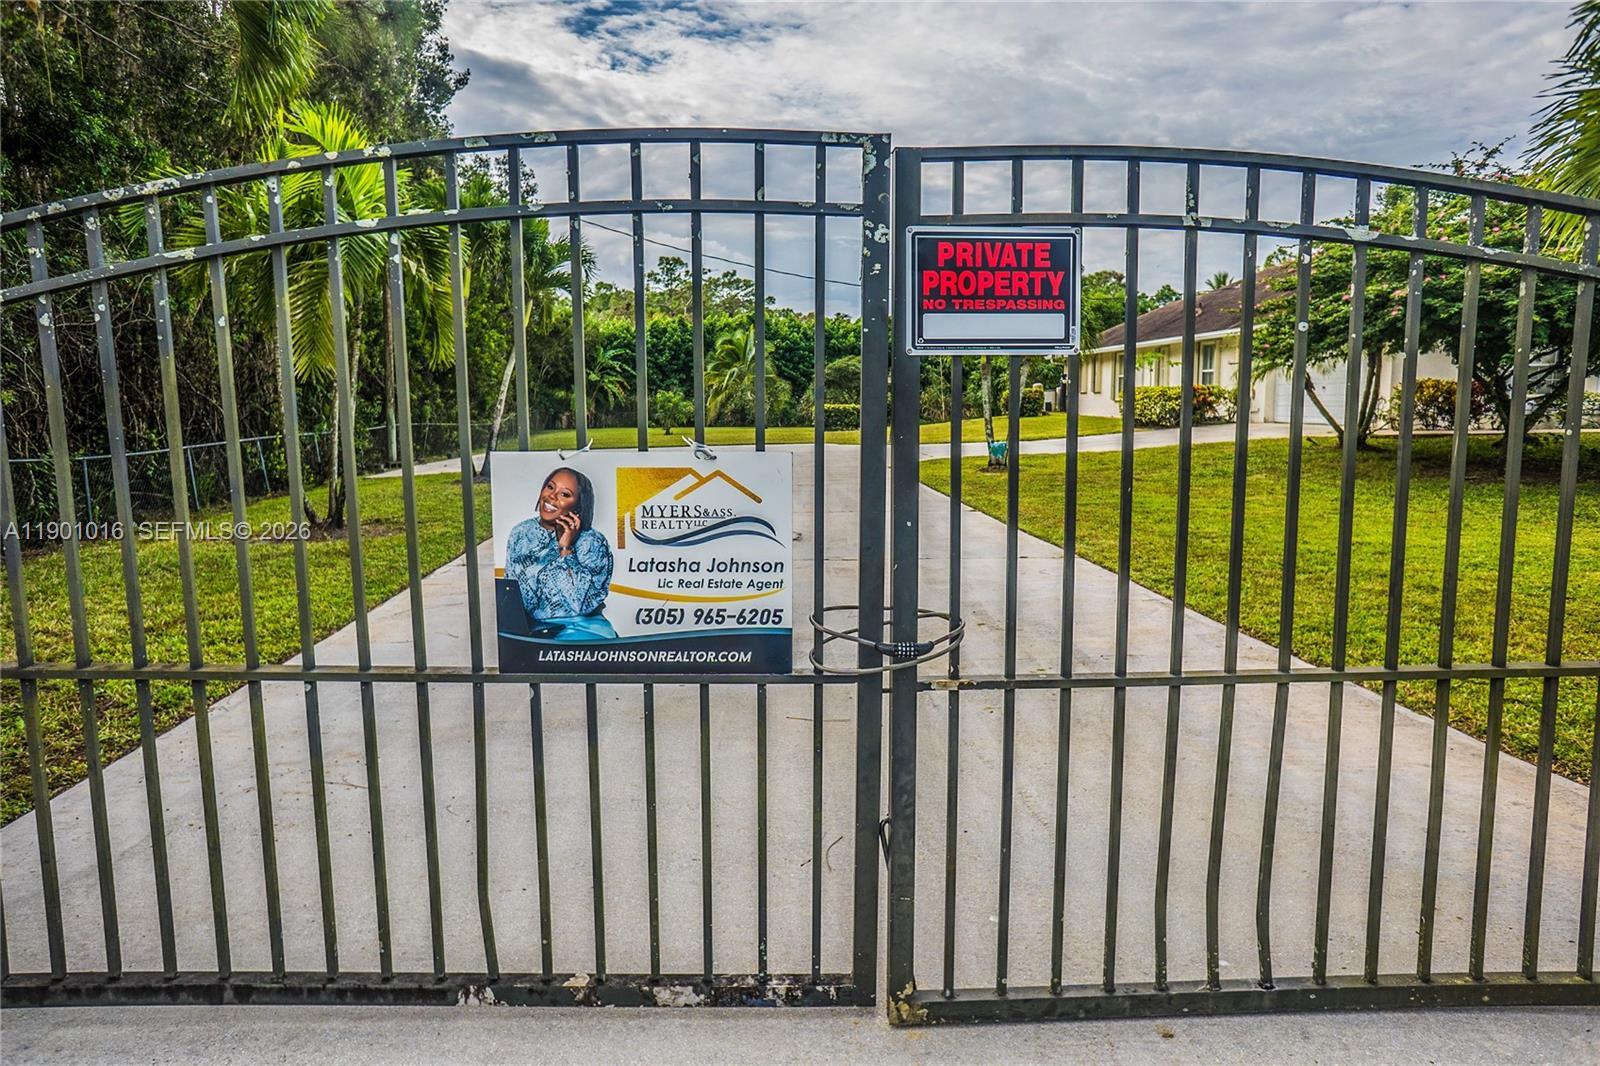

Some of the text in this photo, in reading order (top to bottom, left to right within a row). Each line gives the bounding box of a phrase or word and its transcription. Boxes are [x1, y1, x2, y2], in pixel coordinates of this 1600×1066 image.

[938, 242, 1051, 267] PRIVATE
[922, 271, 1065, 296] PROPERTY
[923, 299, 1065, 310] NO TRESPASSING
[628, 558, 784, 573] Latasha Johnson
[657, 578, 784, 591] Lic Real Estate Agent
[635, 607, 784, 626] (305) 965-6205
[538, 650, 752, 663] LATASHAJOHNSONREALTOR.COM
